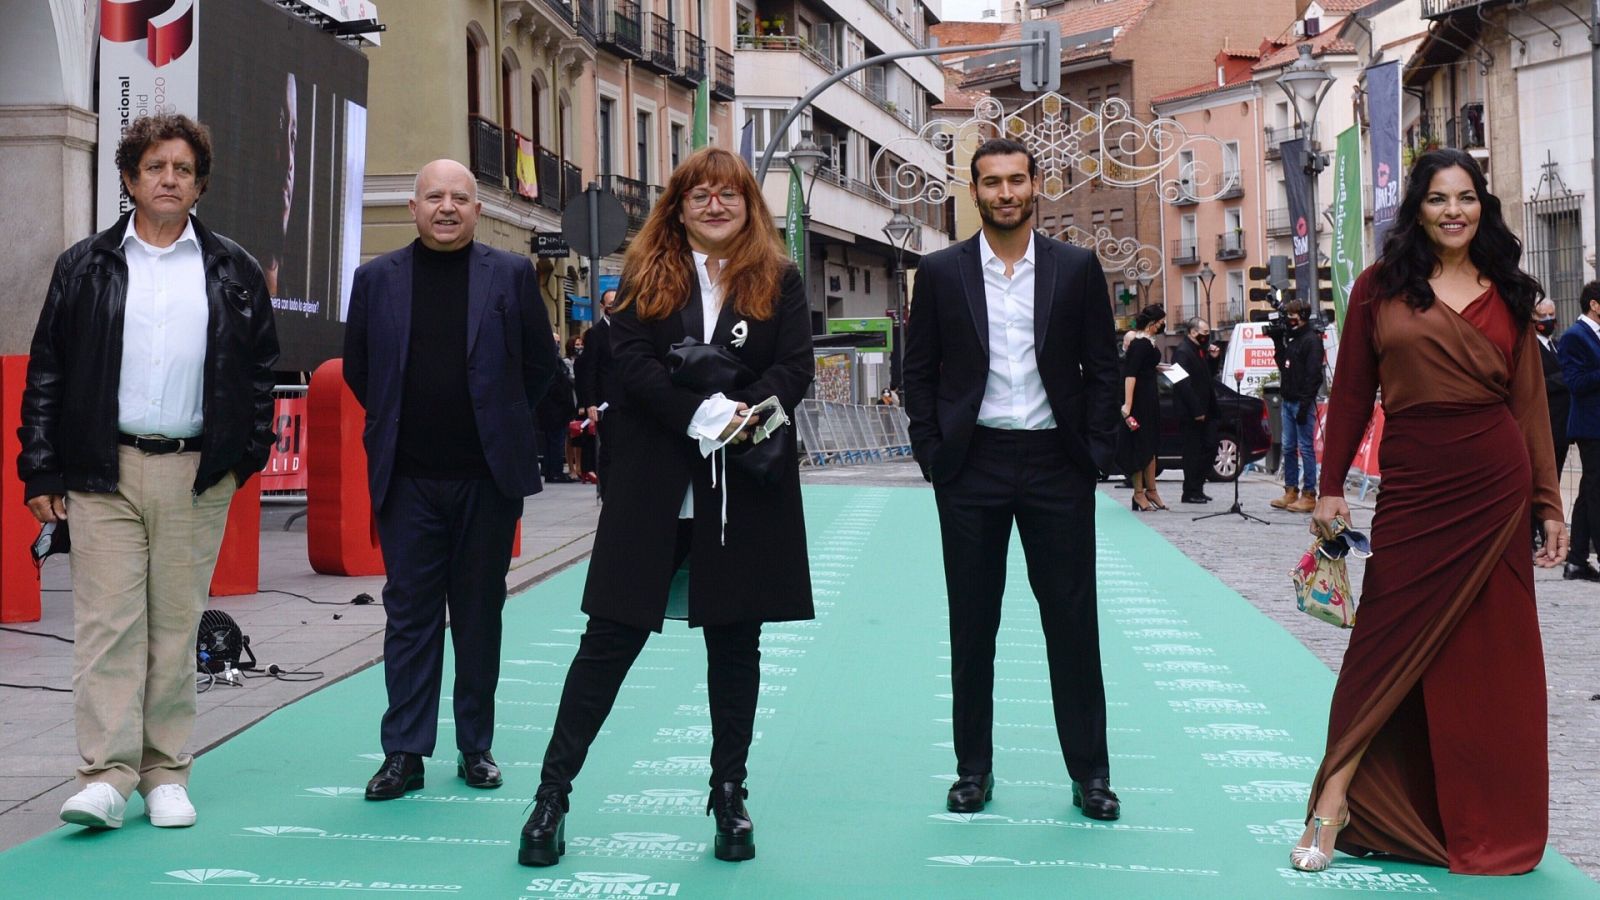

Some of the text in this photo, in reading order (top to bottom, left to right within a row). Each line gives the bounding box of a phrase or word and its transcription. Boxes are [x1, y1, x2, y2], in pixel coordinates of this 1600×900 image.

[1006, 818, 1195, 832] Unicaja Banco
[426, 836, 511, 844] Banco
[568, 836, 708, 853] SEMINCI
[1013, 859, 1219, 874] Unicaja Banco
[249, 877, 463, 890] Unicaja Banco
[526, 878, 681, 897] SEMINCI
